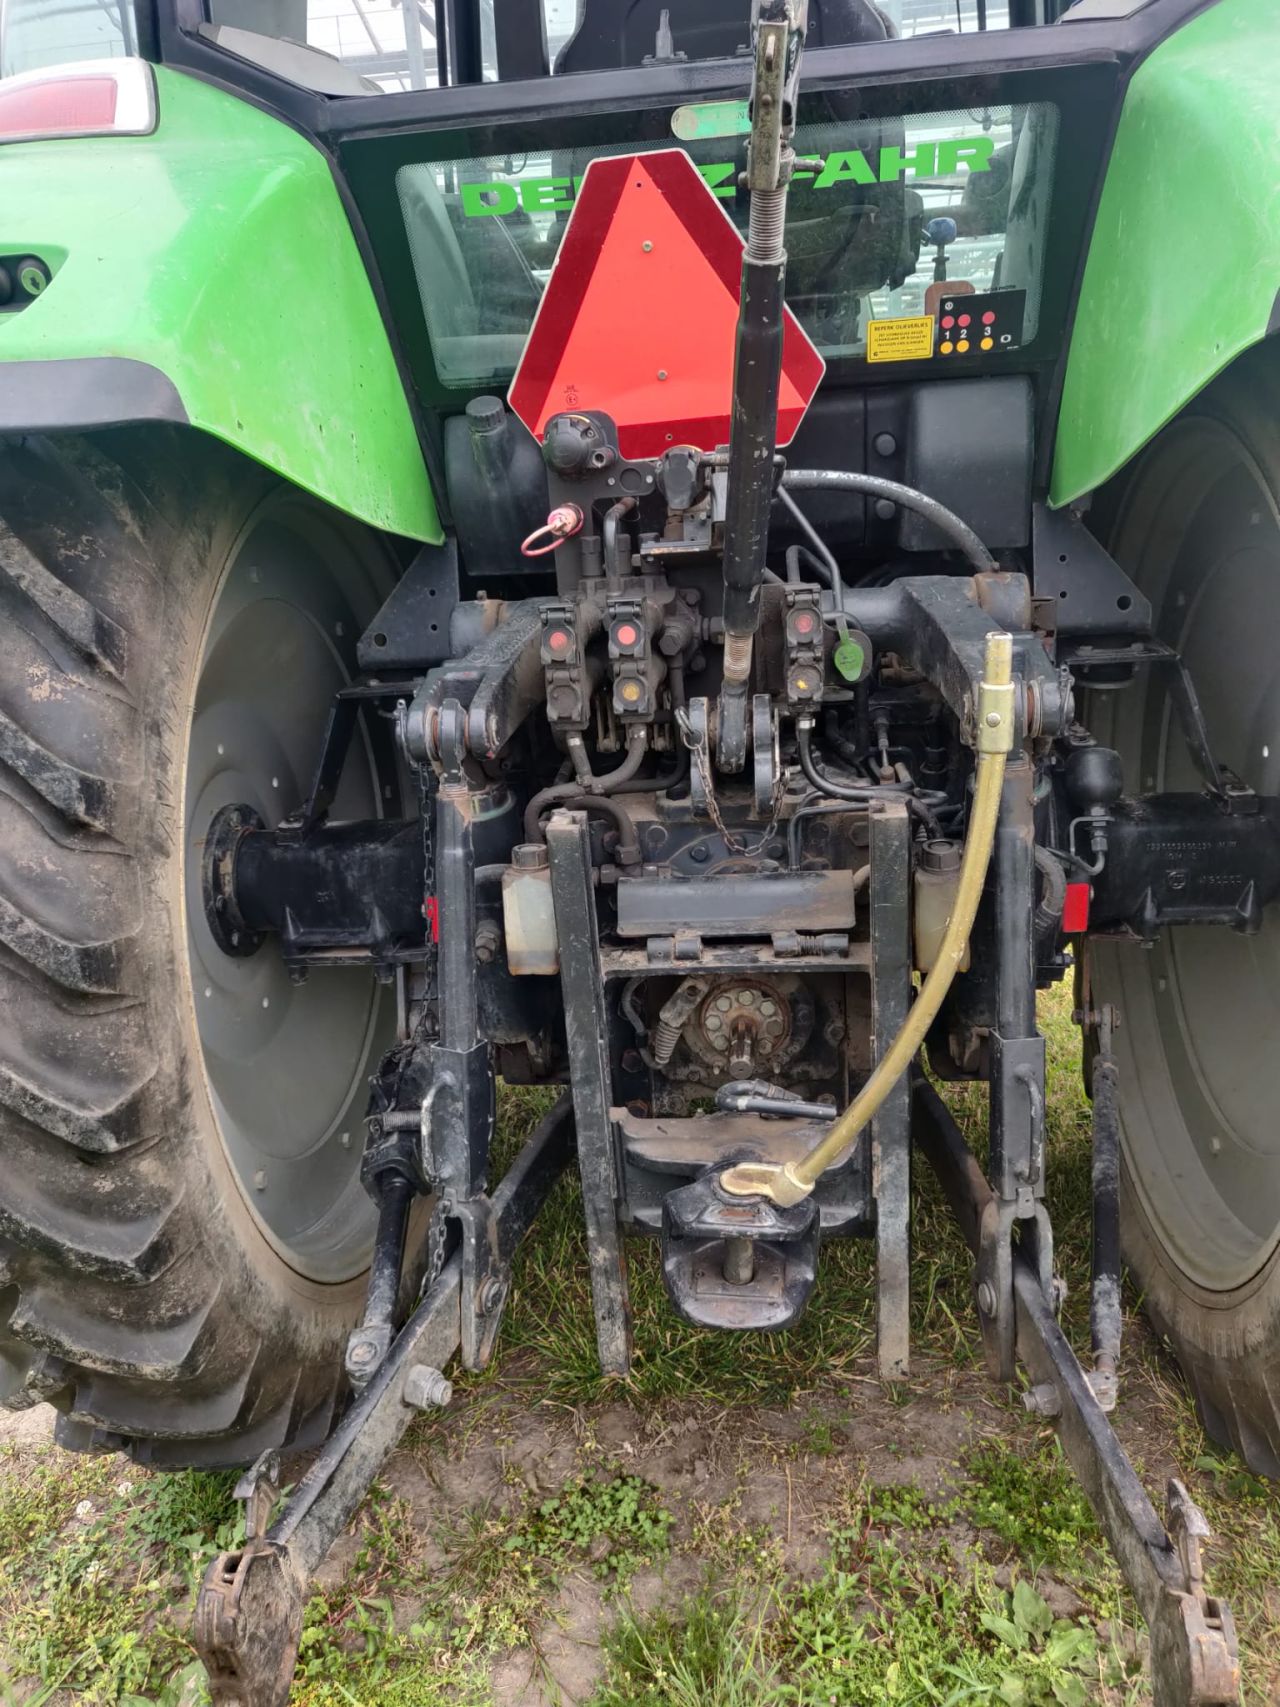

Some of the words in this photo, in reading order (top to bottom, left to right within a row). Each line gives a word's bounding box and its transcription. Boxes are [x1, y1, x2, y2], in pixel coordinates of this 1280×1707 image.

[460, 162, 736, 217] DEZ
[944, 330, 950, 340] 1
[960, 328, 968, 338] 2
[984, 326, 992, 336] 3
